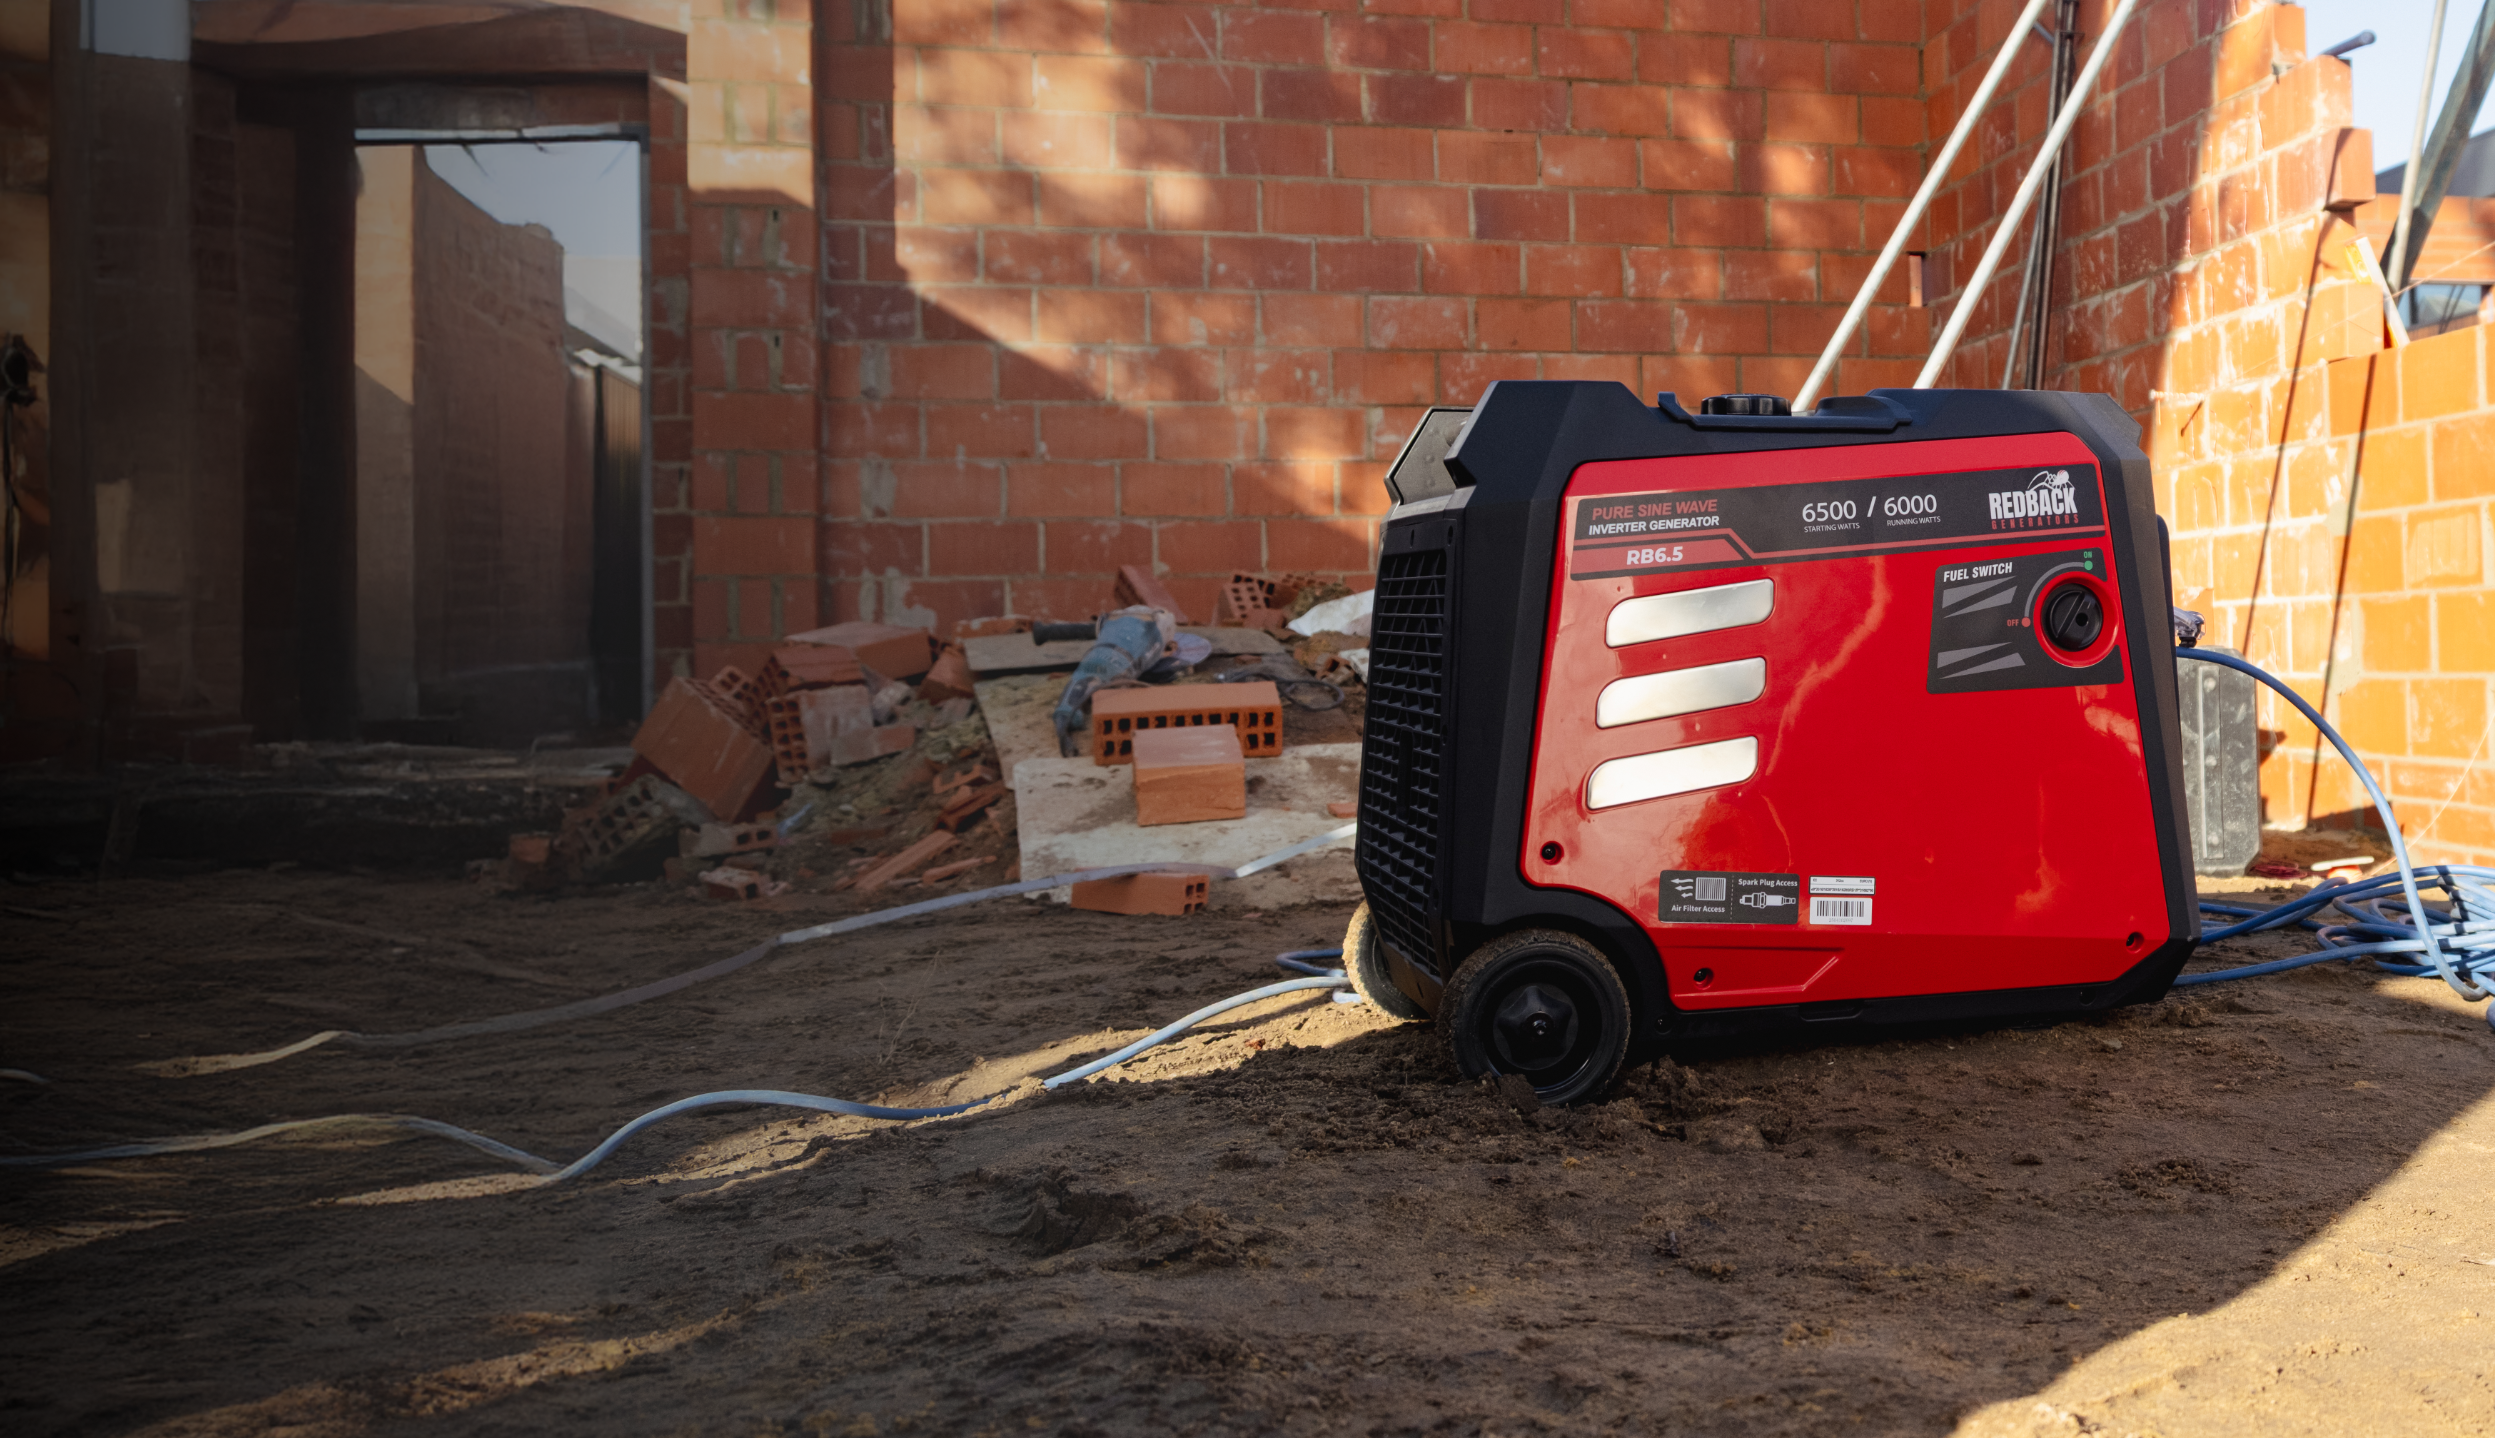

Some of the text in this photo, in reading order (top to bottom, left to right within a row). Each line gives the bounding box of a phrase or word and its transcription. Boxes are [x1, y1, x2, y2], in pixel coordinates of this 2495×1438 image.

[1592, 499, 1718, 521] PURE SINE WAVE
[1802, 494, 1937, 522] 6500 / 6000
[1988, 487, 2078, 520] REDBACK
[1588, 516, 1720, 535] INVERTER GENERATOR
[1804, 522, 1861, 533] STARTING WATTS
[1886, 516, 1941, 527] RUNNING WATTS
[1991, 514, 2079, 530] GENERATORS
[1626, 546, 1683, 565] RB6.5
[2083, 551, 2093, 559] ON
[1943, 562, 2013, 582] FUEL SWITCH
[2006, 619, 2019, 627] OFF
[1760, 879, 1775, 887] Plug
